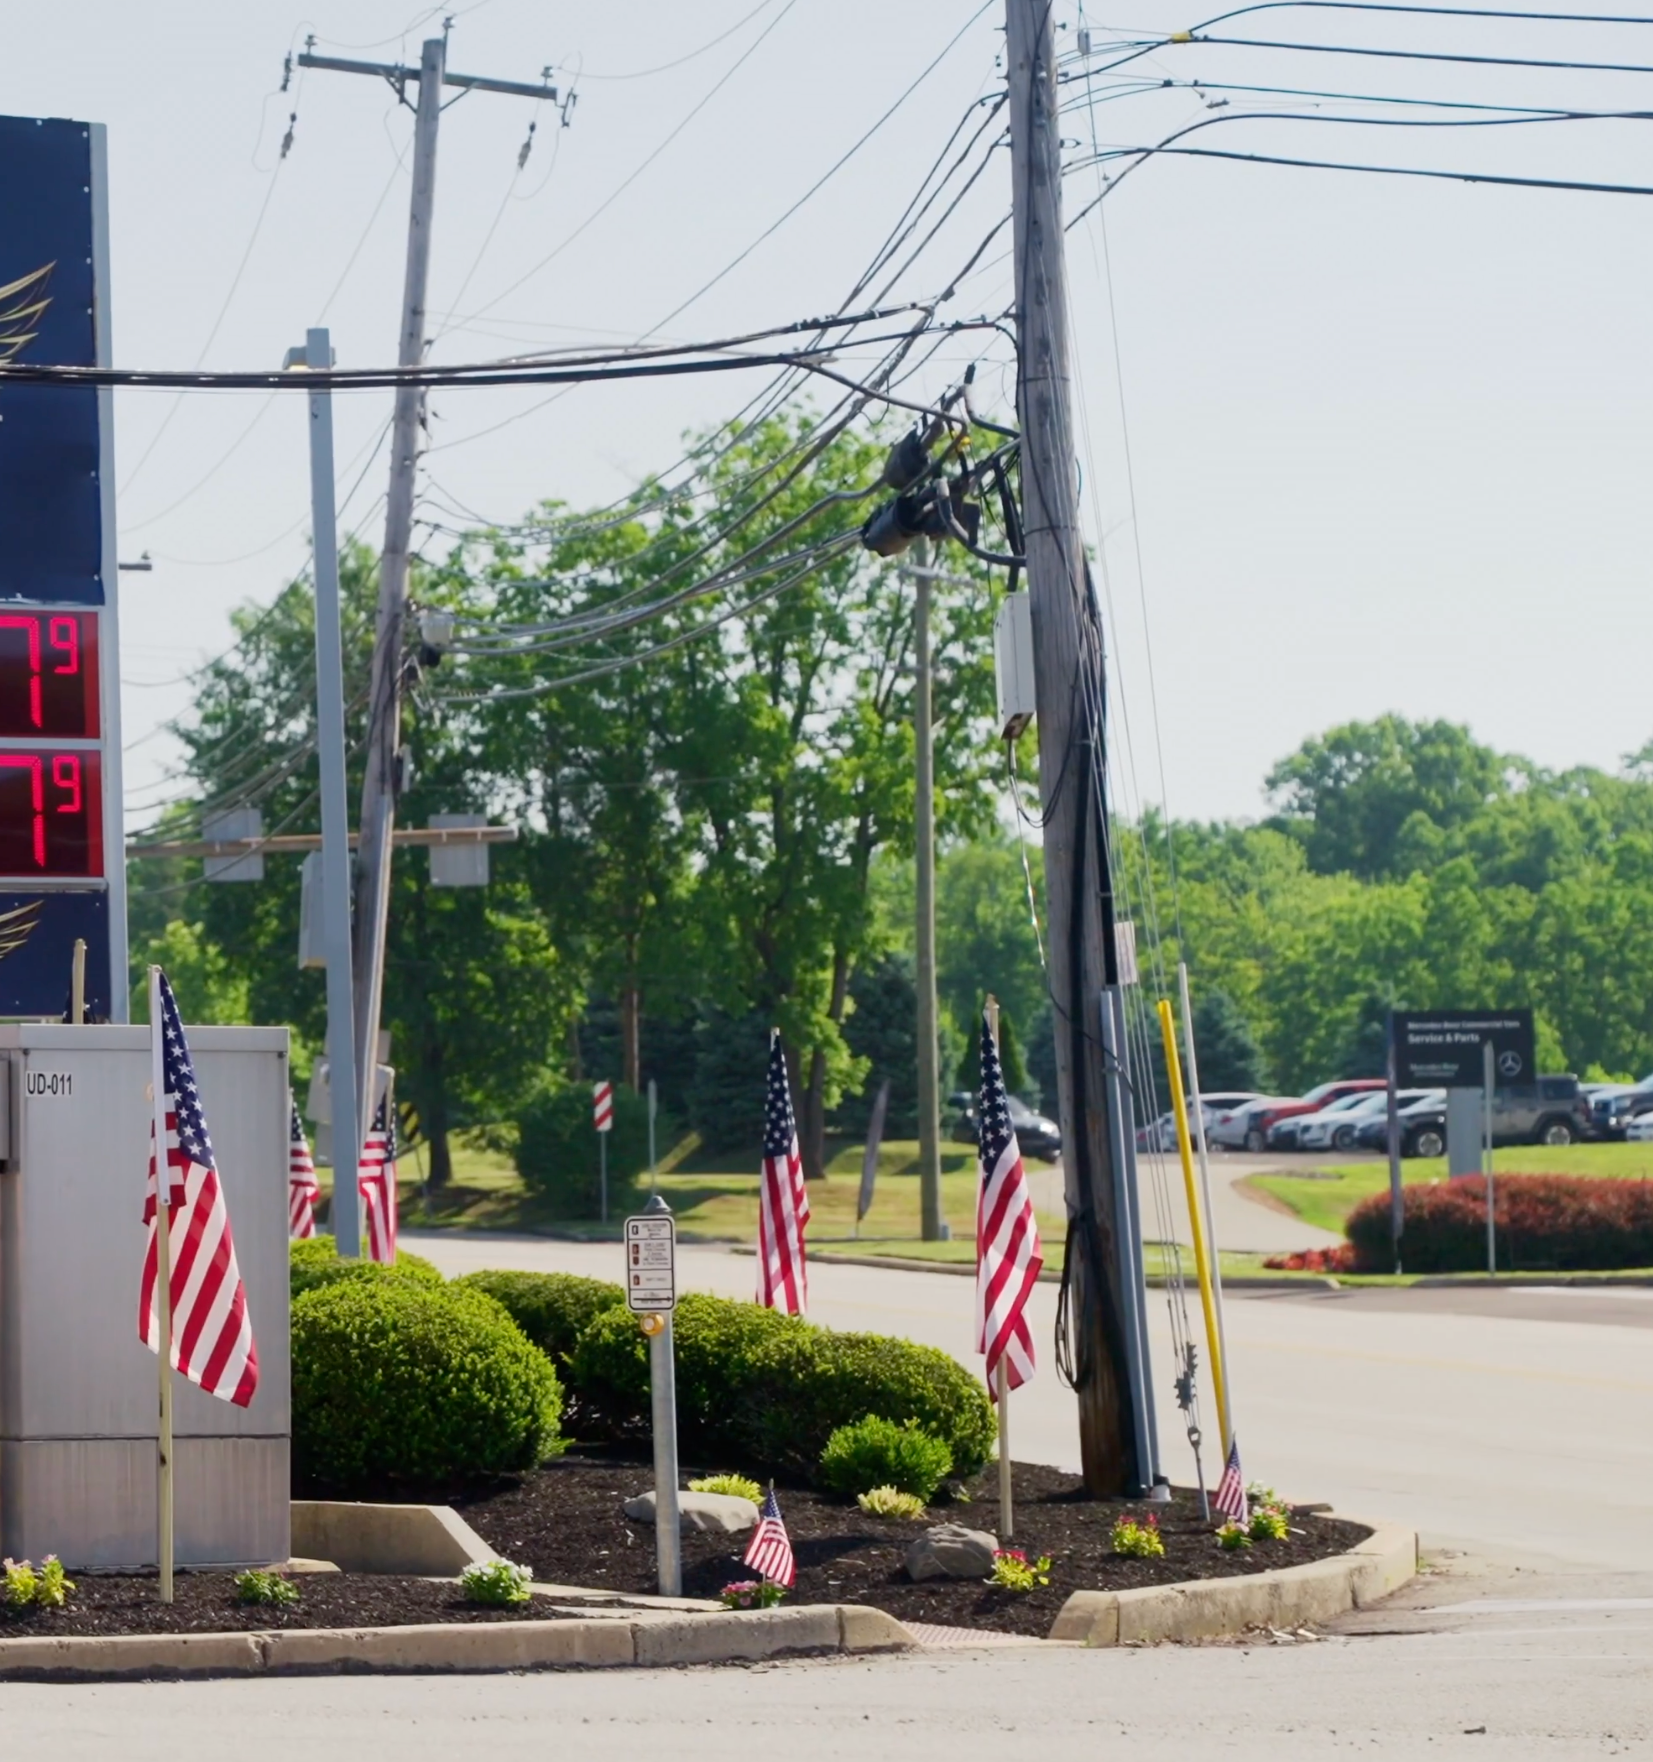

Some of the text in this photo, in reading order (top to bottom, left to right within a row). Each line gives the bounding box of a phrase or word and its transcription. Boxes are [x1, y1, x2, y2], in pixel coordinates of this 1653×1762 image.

[1408, 1033, 1444, 1044] Service
[1454, 1032, 1481, 1044] Parts
[26, 1073, 73, 1096] UD-011
